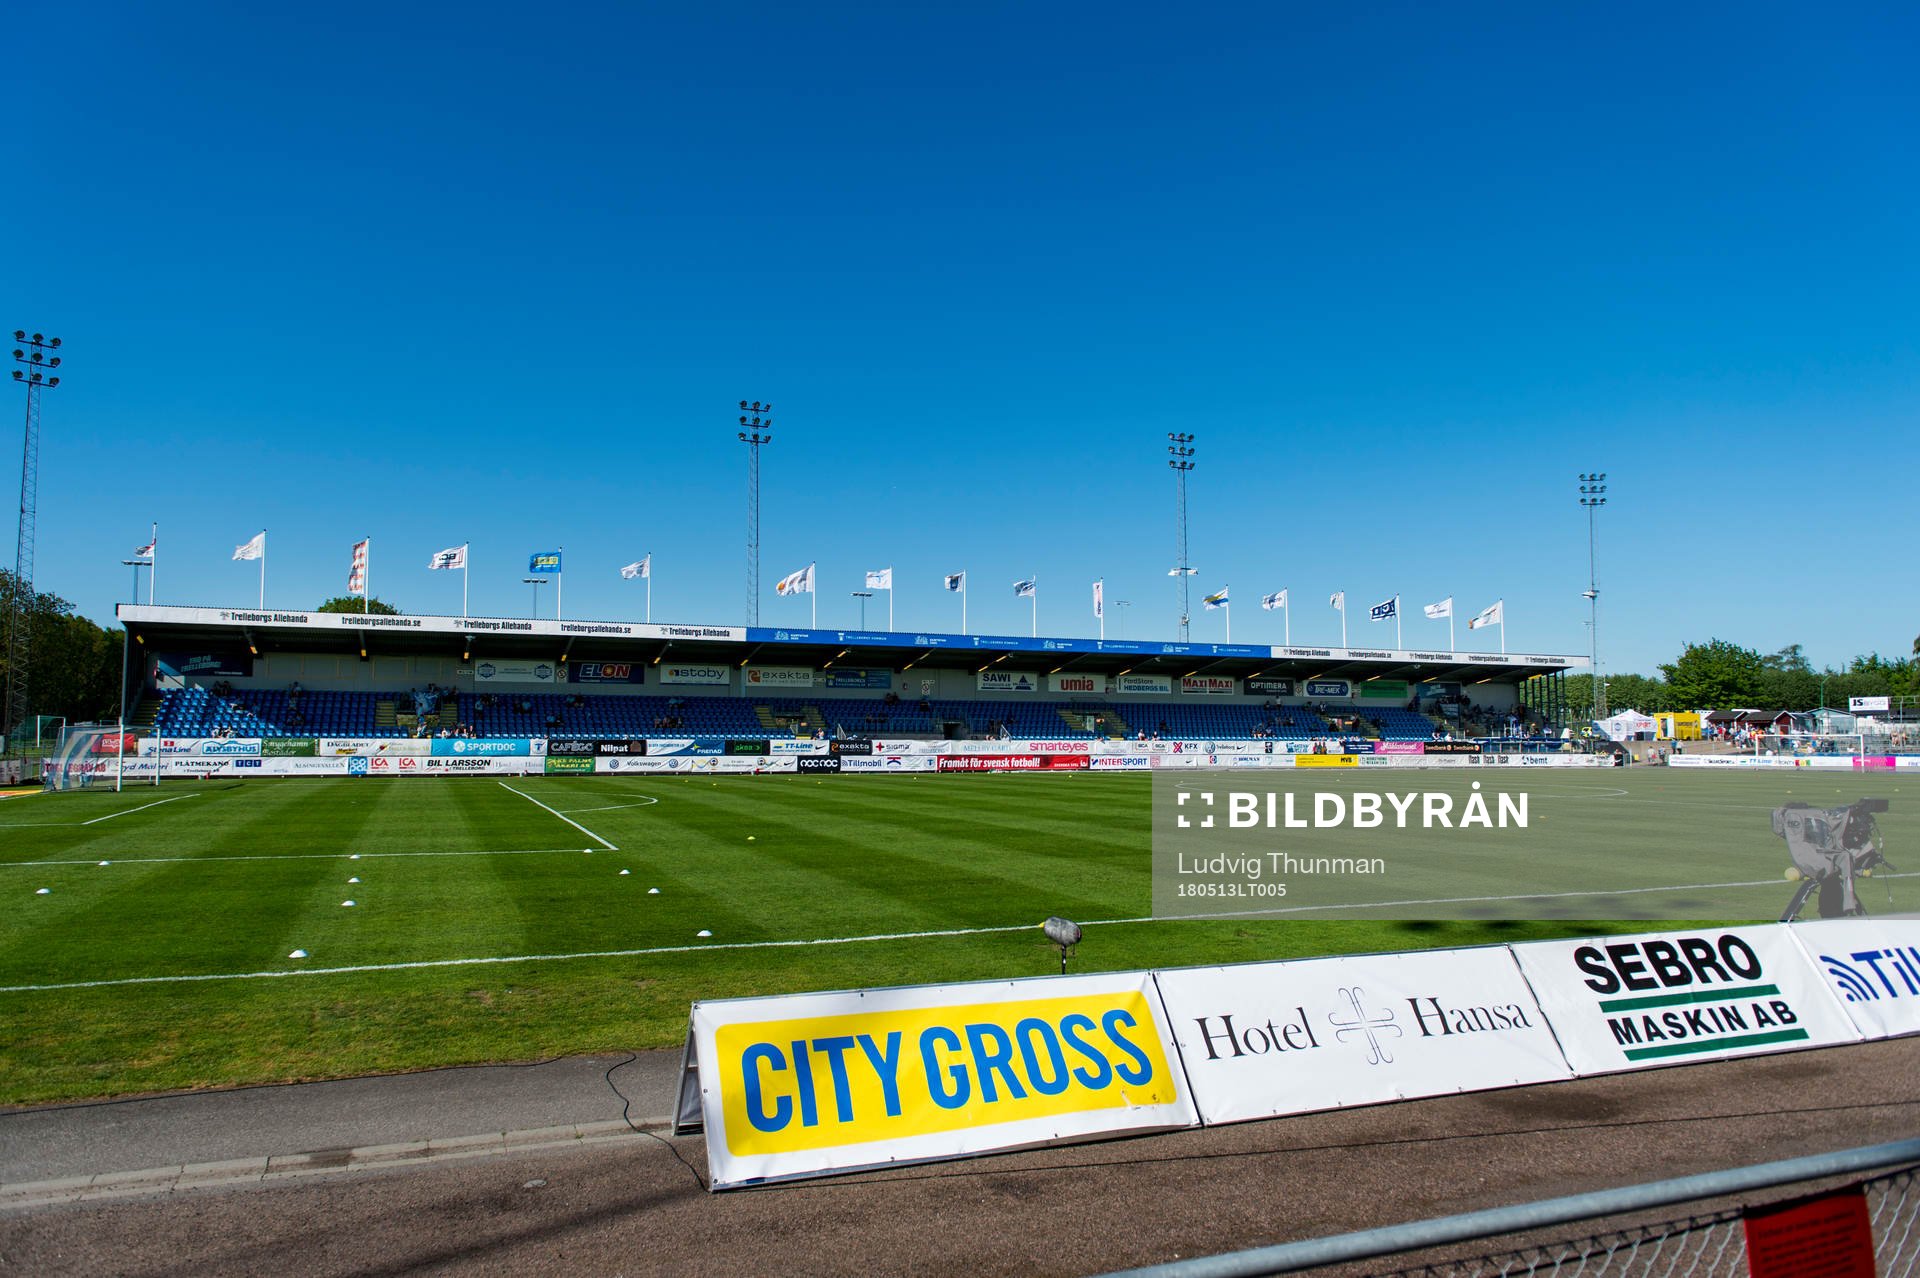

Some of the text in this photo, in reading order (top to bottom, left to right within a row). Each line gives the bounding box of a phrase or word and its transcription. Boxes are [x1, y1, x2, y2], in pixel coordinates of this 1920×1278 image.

[231, 611, 308, 624] Trelleborgs Allehanda
[342, 616, 421, 627] trelleborgsallehanda.se
[464, 620, 532, 631] Trelleborgs Allehanda
[561, 623, 631, 634] trelleborgsallehanda.se
[669, 627, 730, 638] Trelleborgs Allehanda
[579, 663, 631, 679] ELON
[763, 671, 810, 680] exakta
[983, 673, 1011, 683] SAWI
[1061, 676, 1094, 691] umia
[1183, 678, 1233, 689] MAXI MAXI
[1251, 681, 1287, 689] OPTIMERA
[467, 742, 516, 751] SPORTDOC
[600, 744, 629, 753] Nilpat
[1029, 741, 1088, 753] smarteyes
[371, 757, 416, 767] ICA ICA
[427, 759, 491, 767] BIL LARSSON
[939, 757, 1040, 768] Framåt för svensk fotboll!
[1099, 758, 1147, 766] INTERSPORT
[1573, 934, 1763, 995] SEBRO
[1194, 996, 1534, 1061] Hotel Hansa
[1606, 1000, 1798, 1046] MASKIN AB
[741, 1009, 1154, 1133] CITY GROSS
